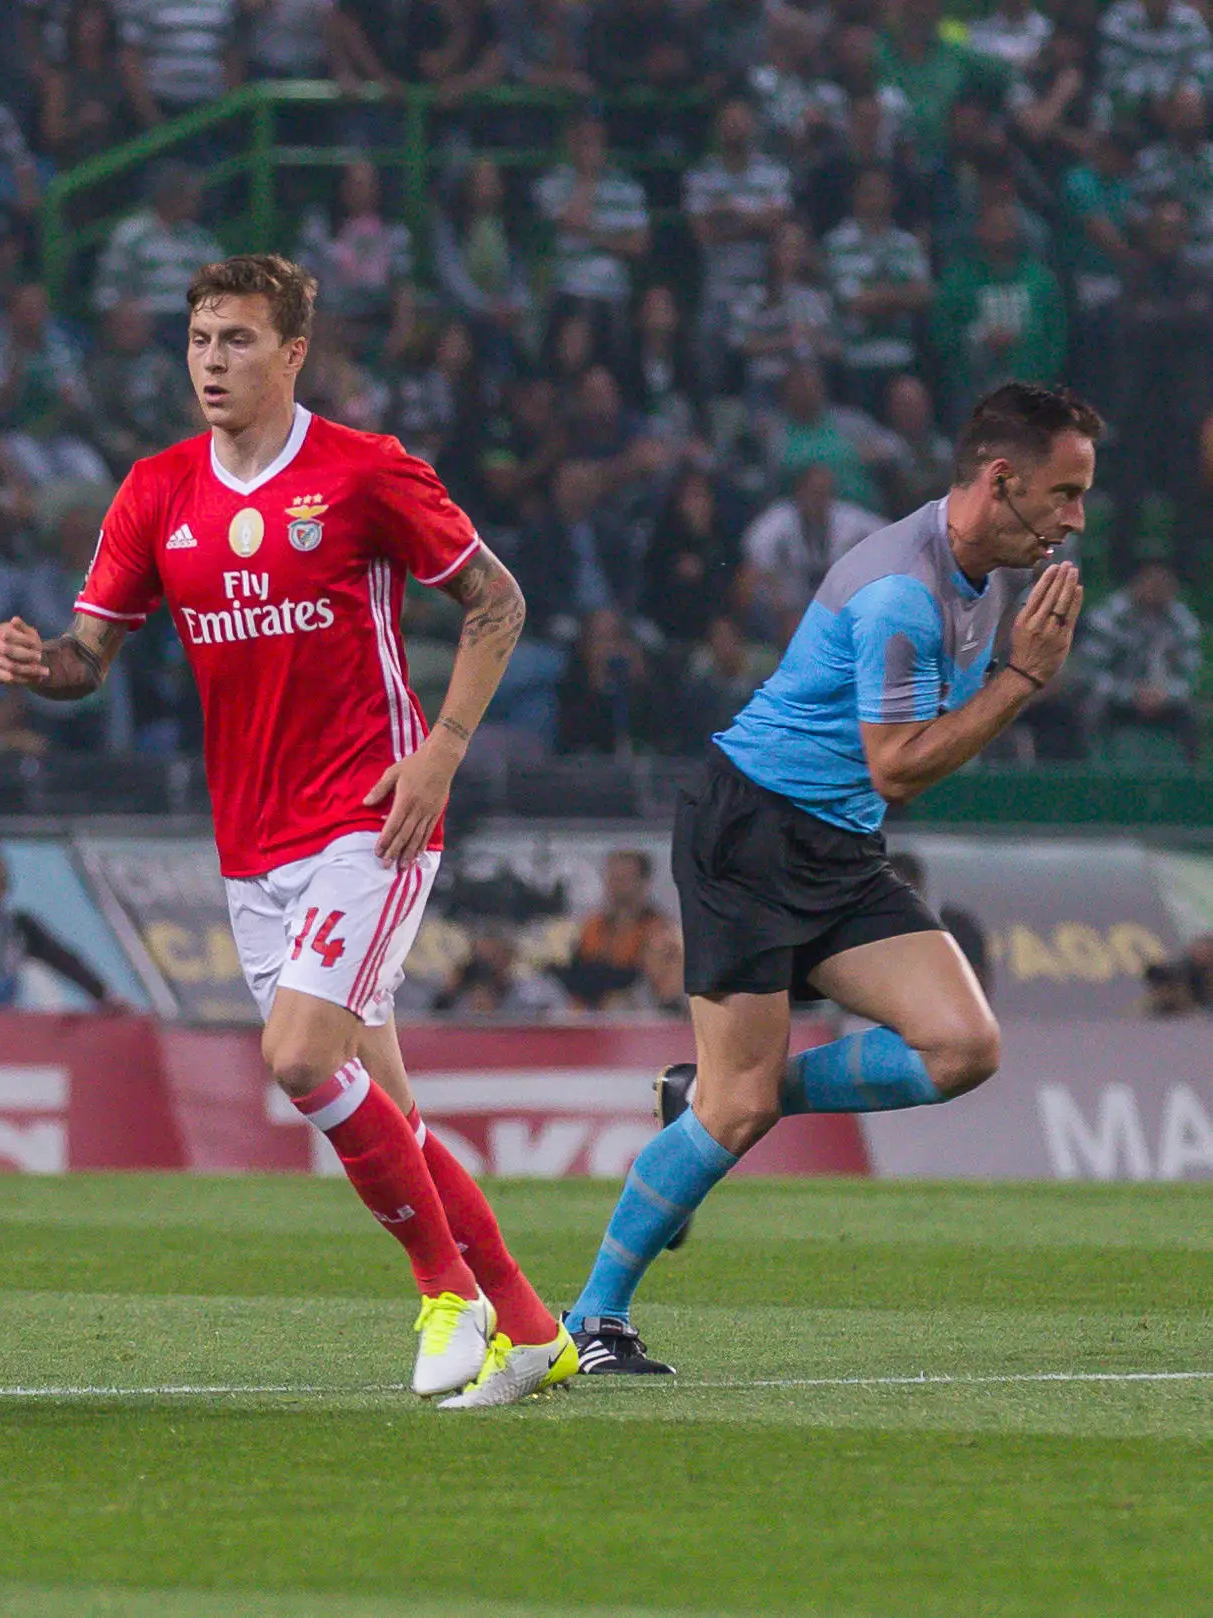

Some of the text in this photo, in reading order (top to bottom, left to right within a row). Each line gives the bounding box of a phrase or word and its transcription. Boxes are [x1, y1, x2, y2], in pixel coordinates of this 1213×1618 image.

[223, 570, 269, 600] Fly
[181, 598, 335, 645] Emirates
[291, 906, 346, 968] 14
